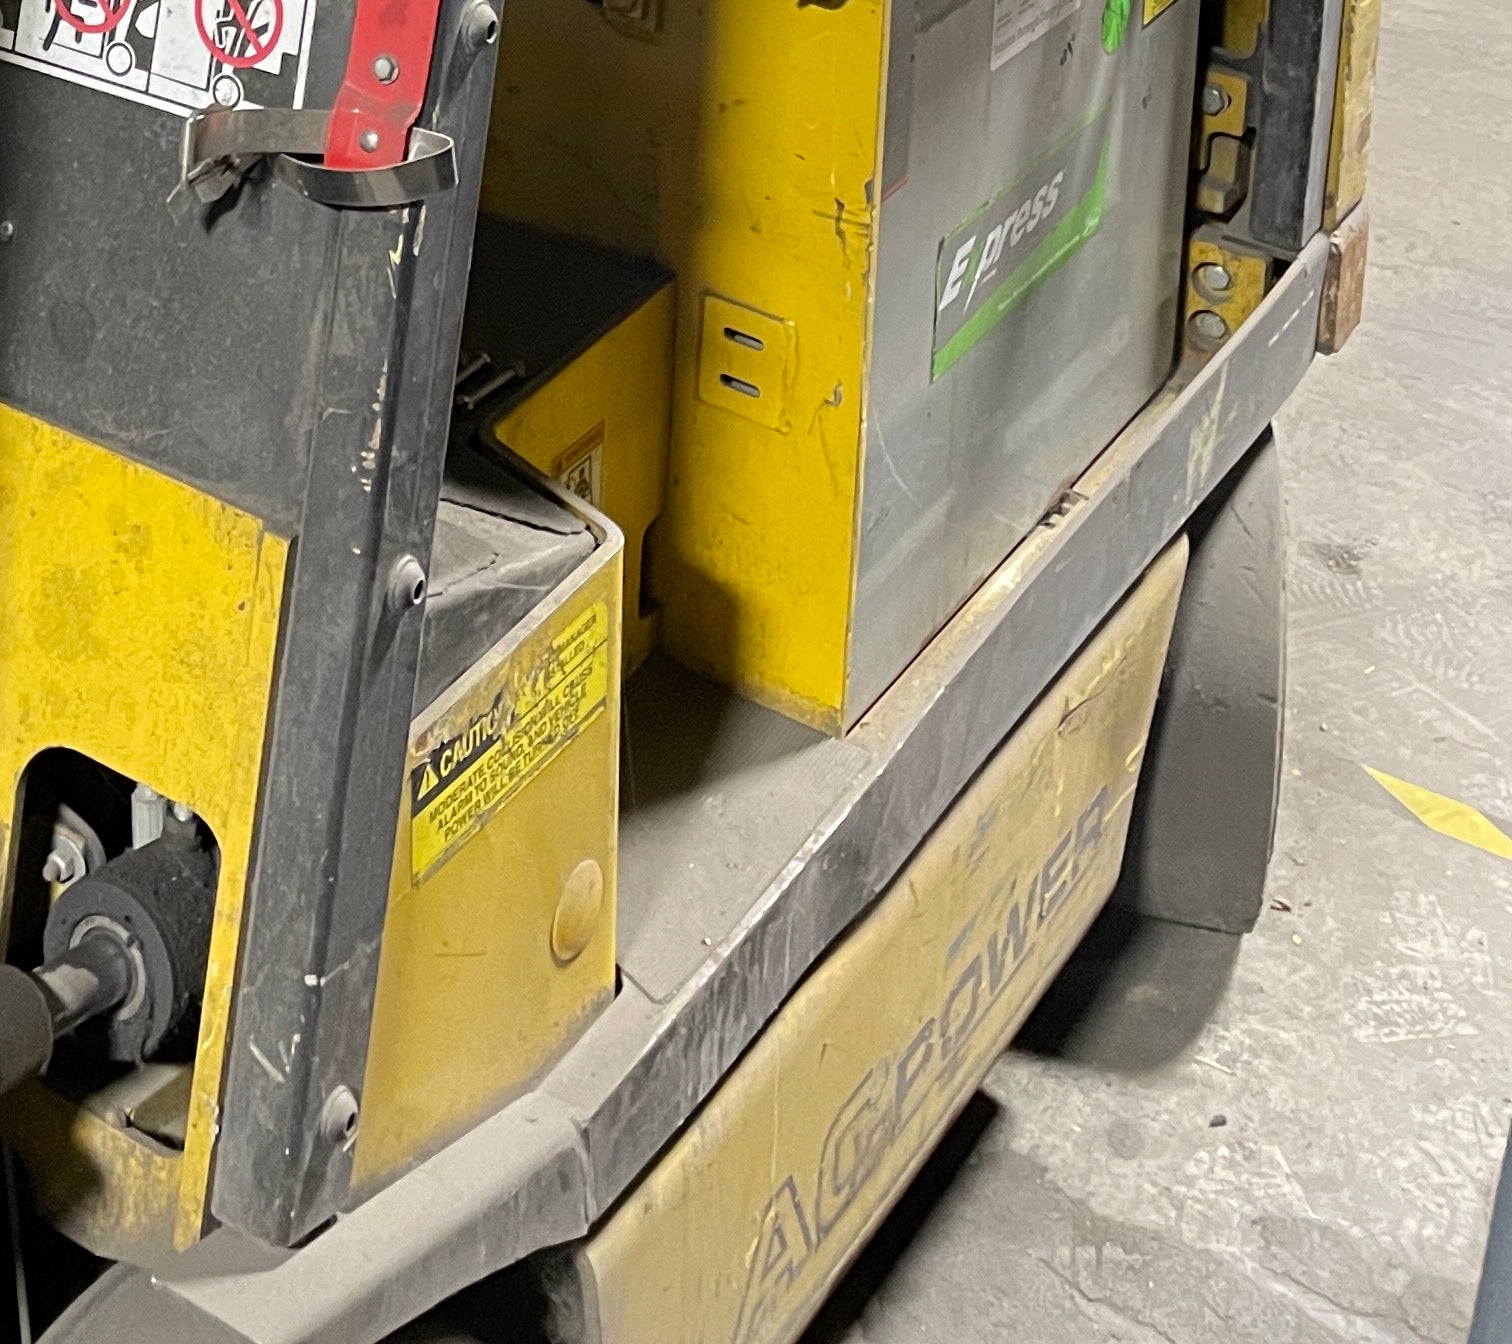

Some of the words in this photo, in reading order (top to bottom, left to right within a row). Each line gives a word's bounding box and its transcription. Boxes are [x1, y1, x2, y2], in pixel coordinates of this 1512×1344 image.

[438, 696, 501, 785] CAUTIO
[428, 761, 484, 827] MODERATE
[436, 788, 473, 835] ALARM
[474, 775, 487, 800] TO
[443, 795, 483, 844] POWER
[892, 783, 1111, 1122] POWER
